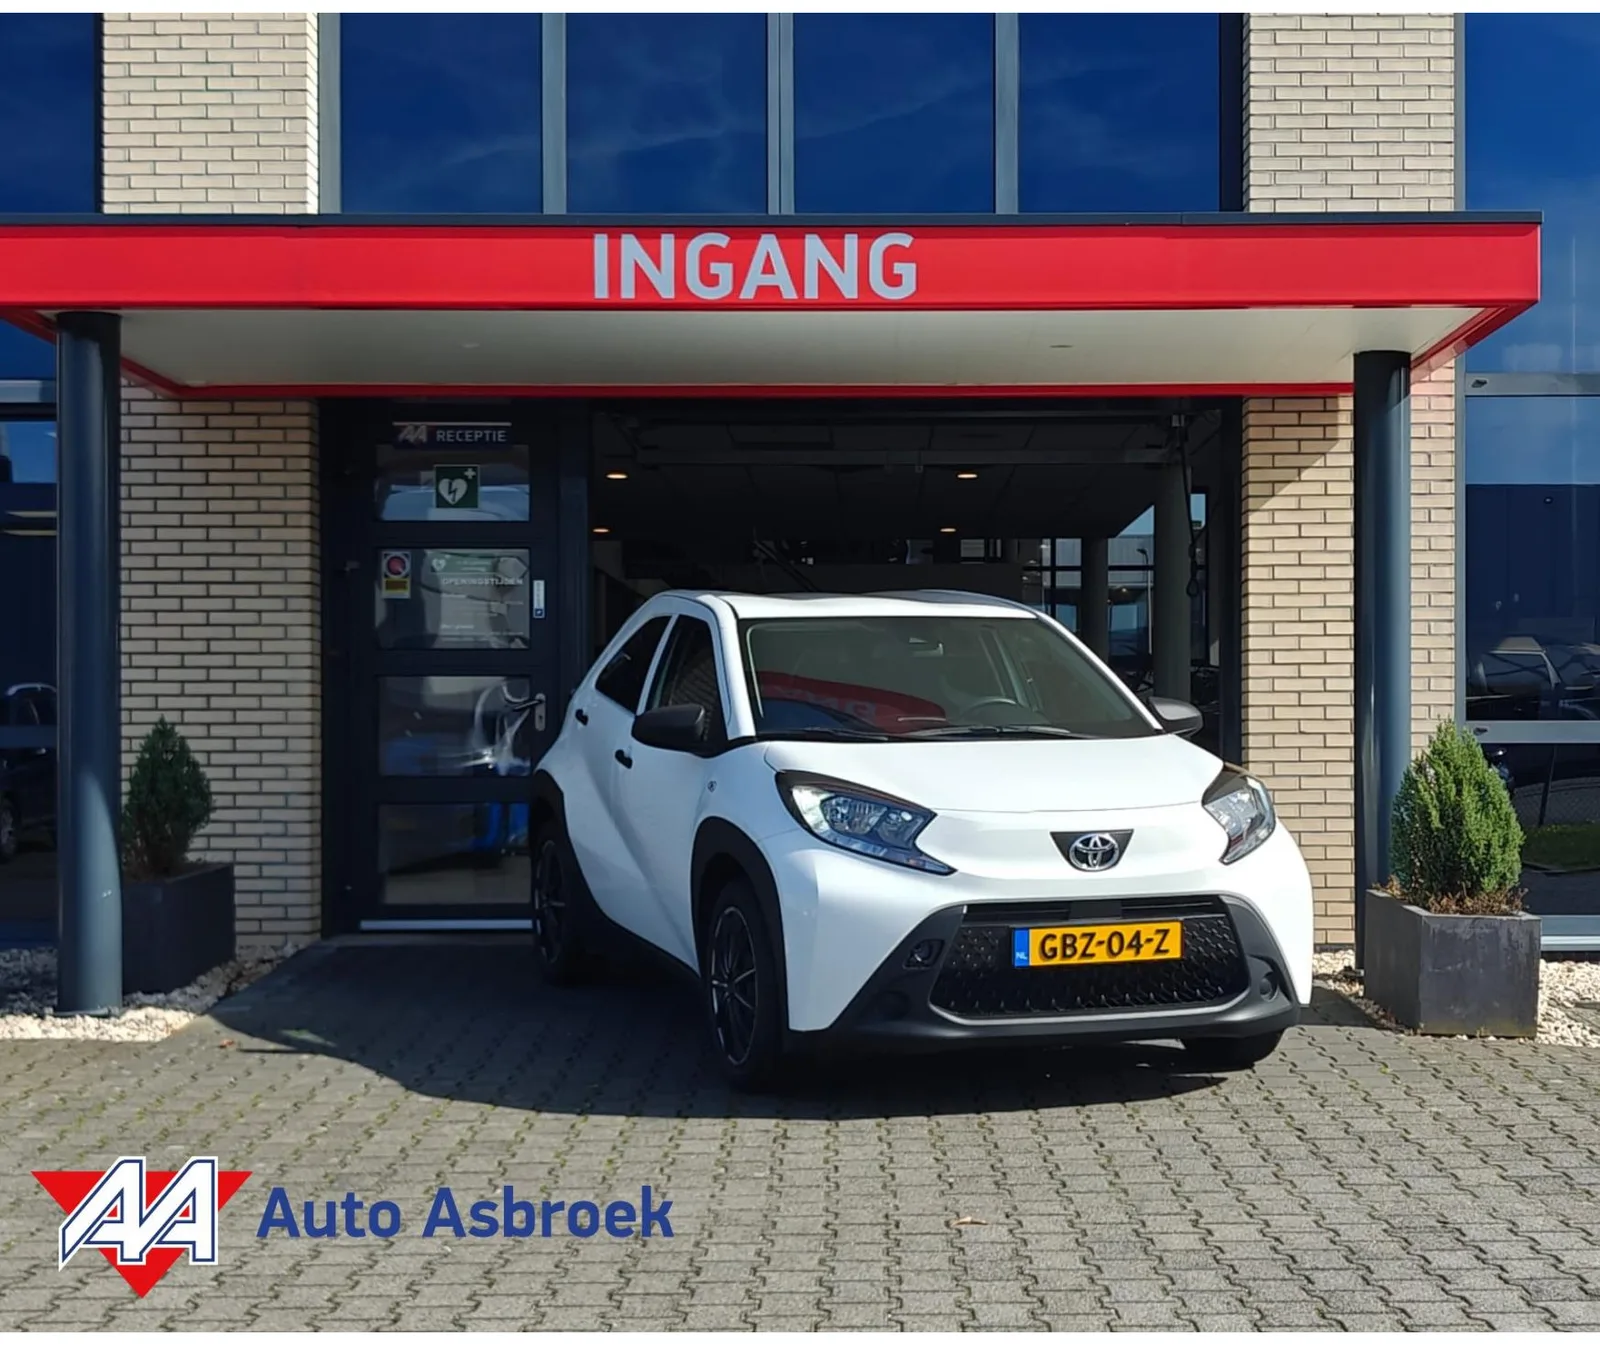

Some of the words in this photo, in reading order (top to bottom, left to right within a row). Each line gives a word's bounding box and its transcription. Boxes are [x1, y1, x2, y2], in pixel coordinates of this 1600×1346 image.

[593, 232, 917, 300] INGANG
[436, 430, 507, 442] RECEPTIE
[1015, 952, 1028, 960] NL
[1039, 929, 1170, 961] GBZ-04-Z
